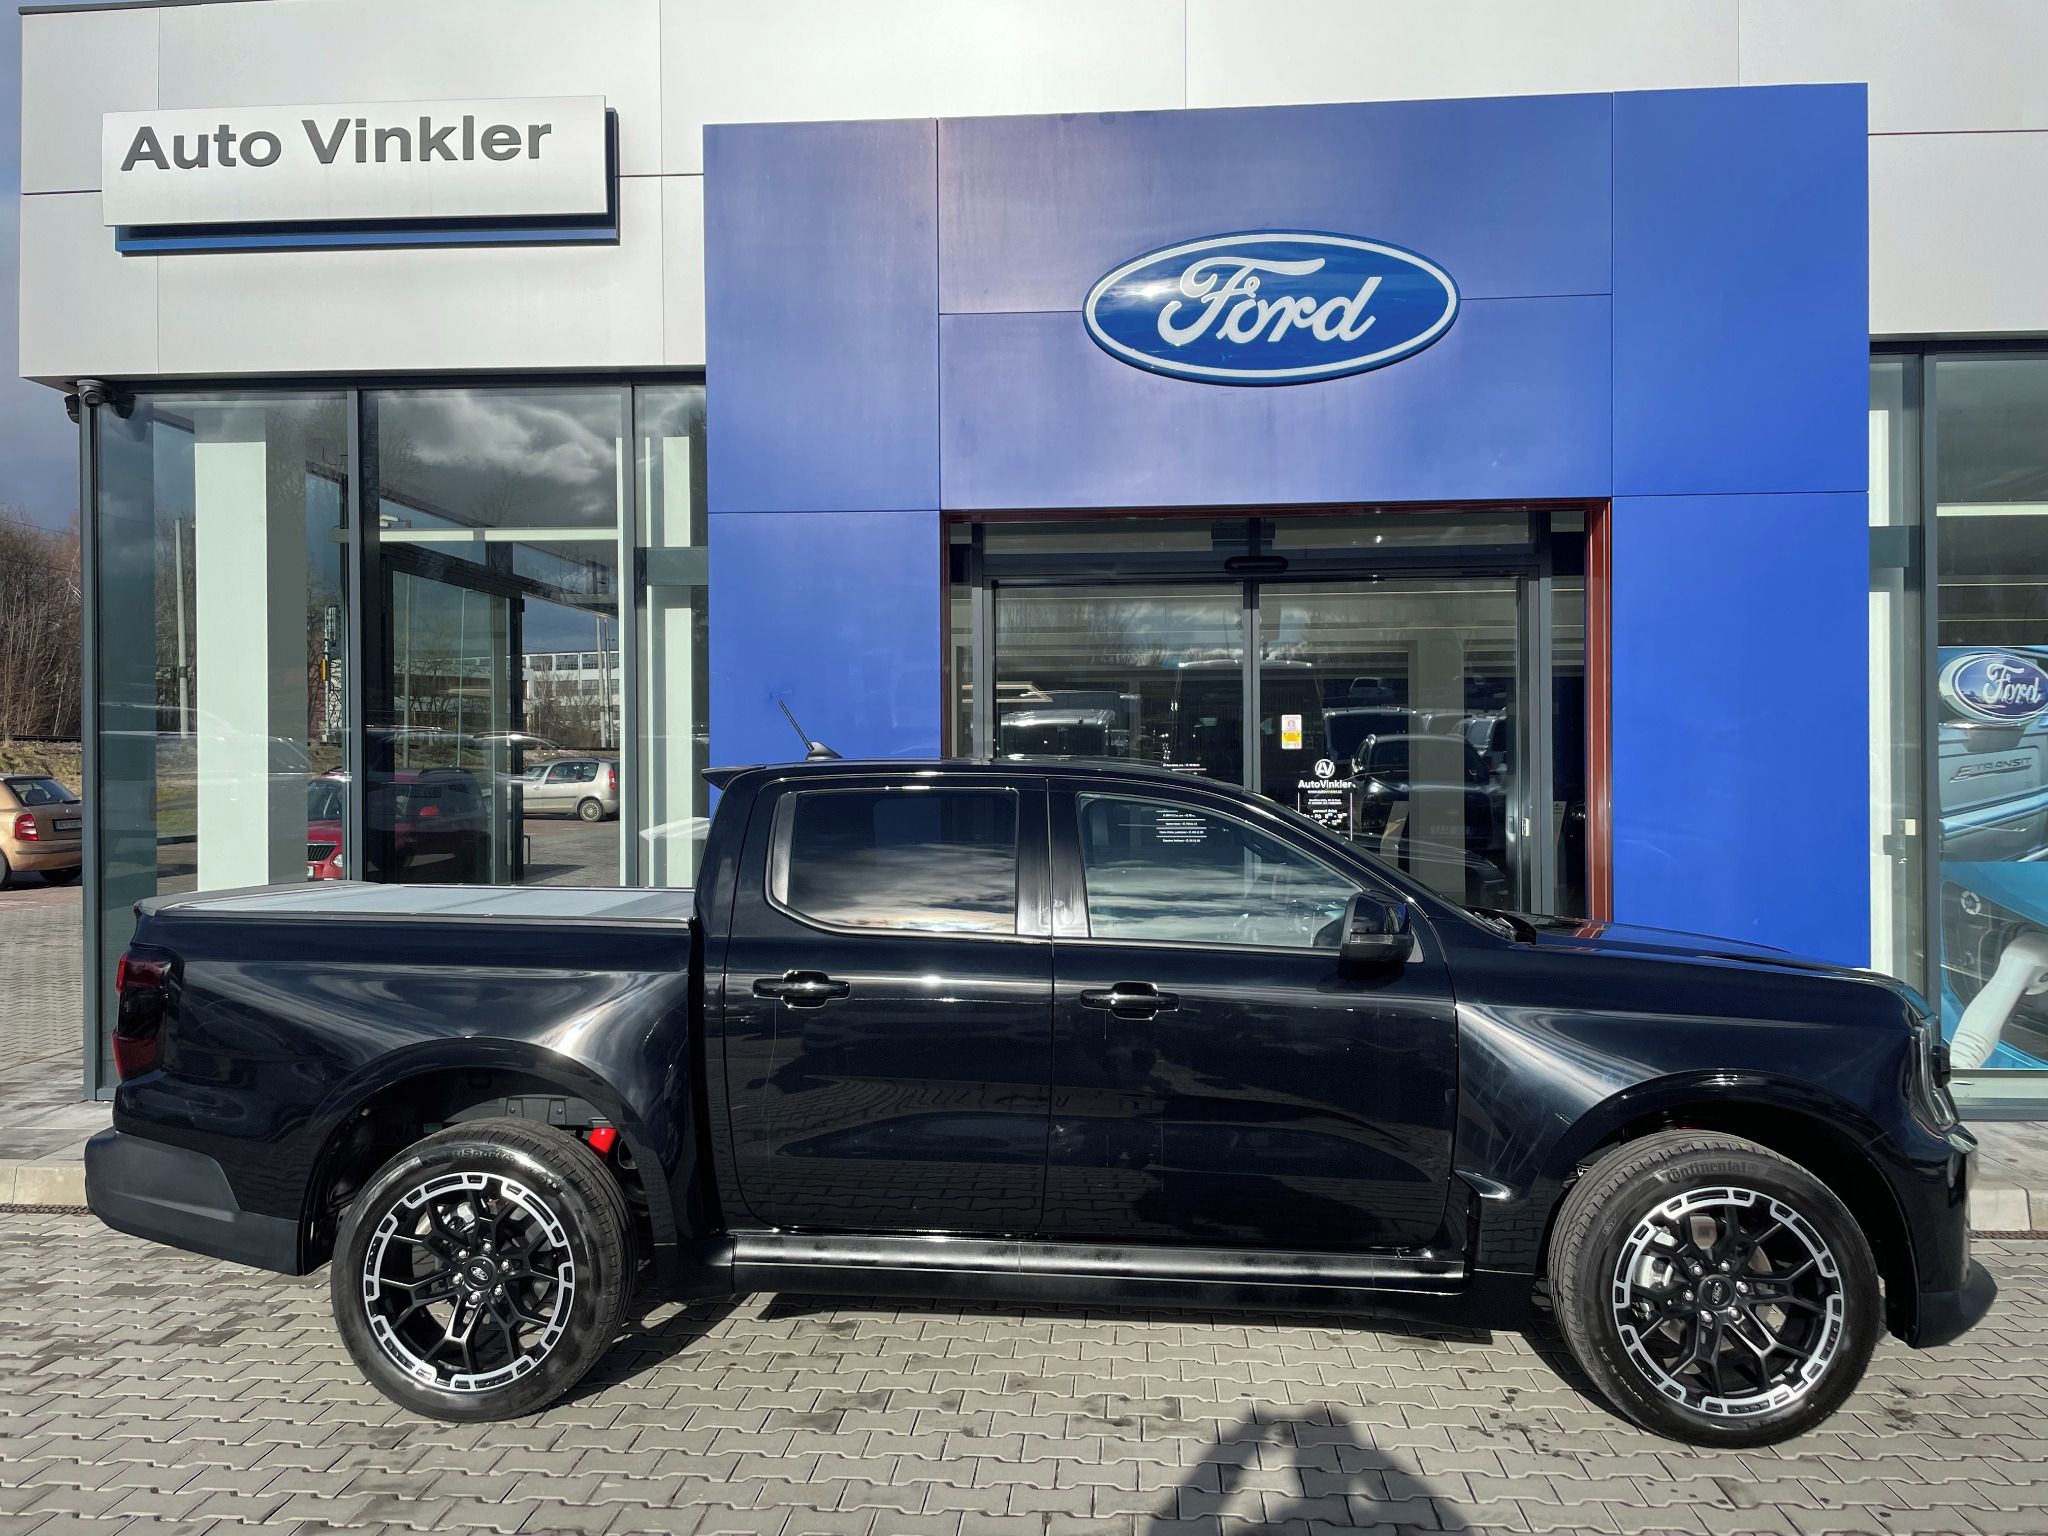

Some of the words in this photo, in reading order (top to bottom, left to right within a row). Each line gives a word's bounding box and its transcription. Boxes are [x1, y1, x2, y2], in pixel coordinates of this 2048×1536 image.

[120, 124, 282, 172] Auto
[301, 115, 552, 164] Vinkler
[1157, 256, 1383, 346] Ford
[1983, 663, 2041, 704] Ford
[1298, 780, 1352, 788] AutoVinkler
[1667, 1161, 1746, 1183] Continental
